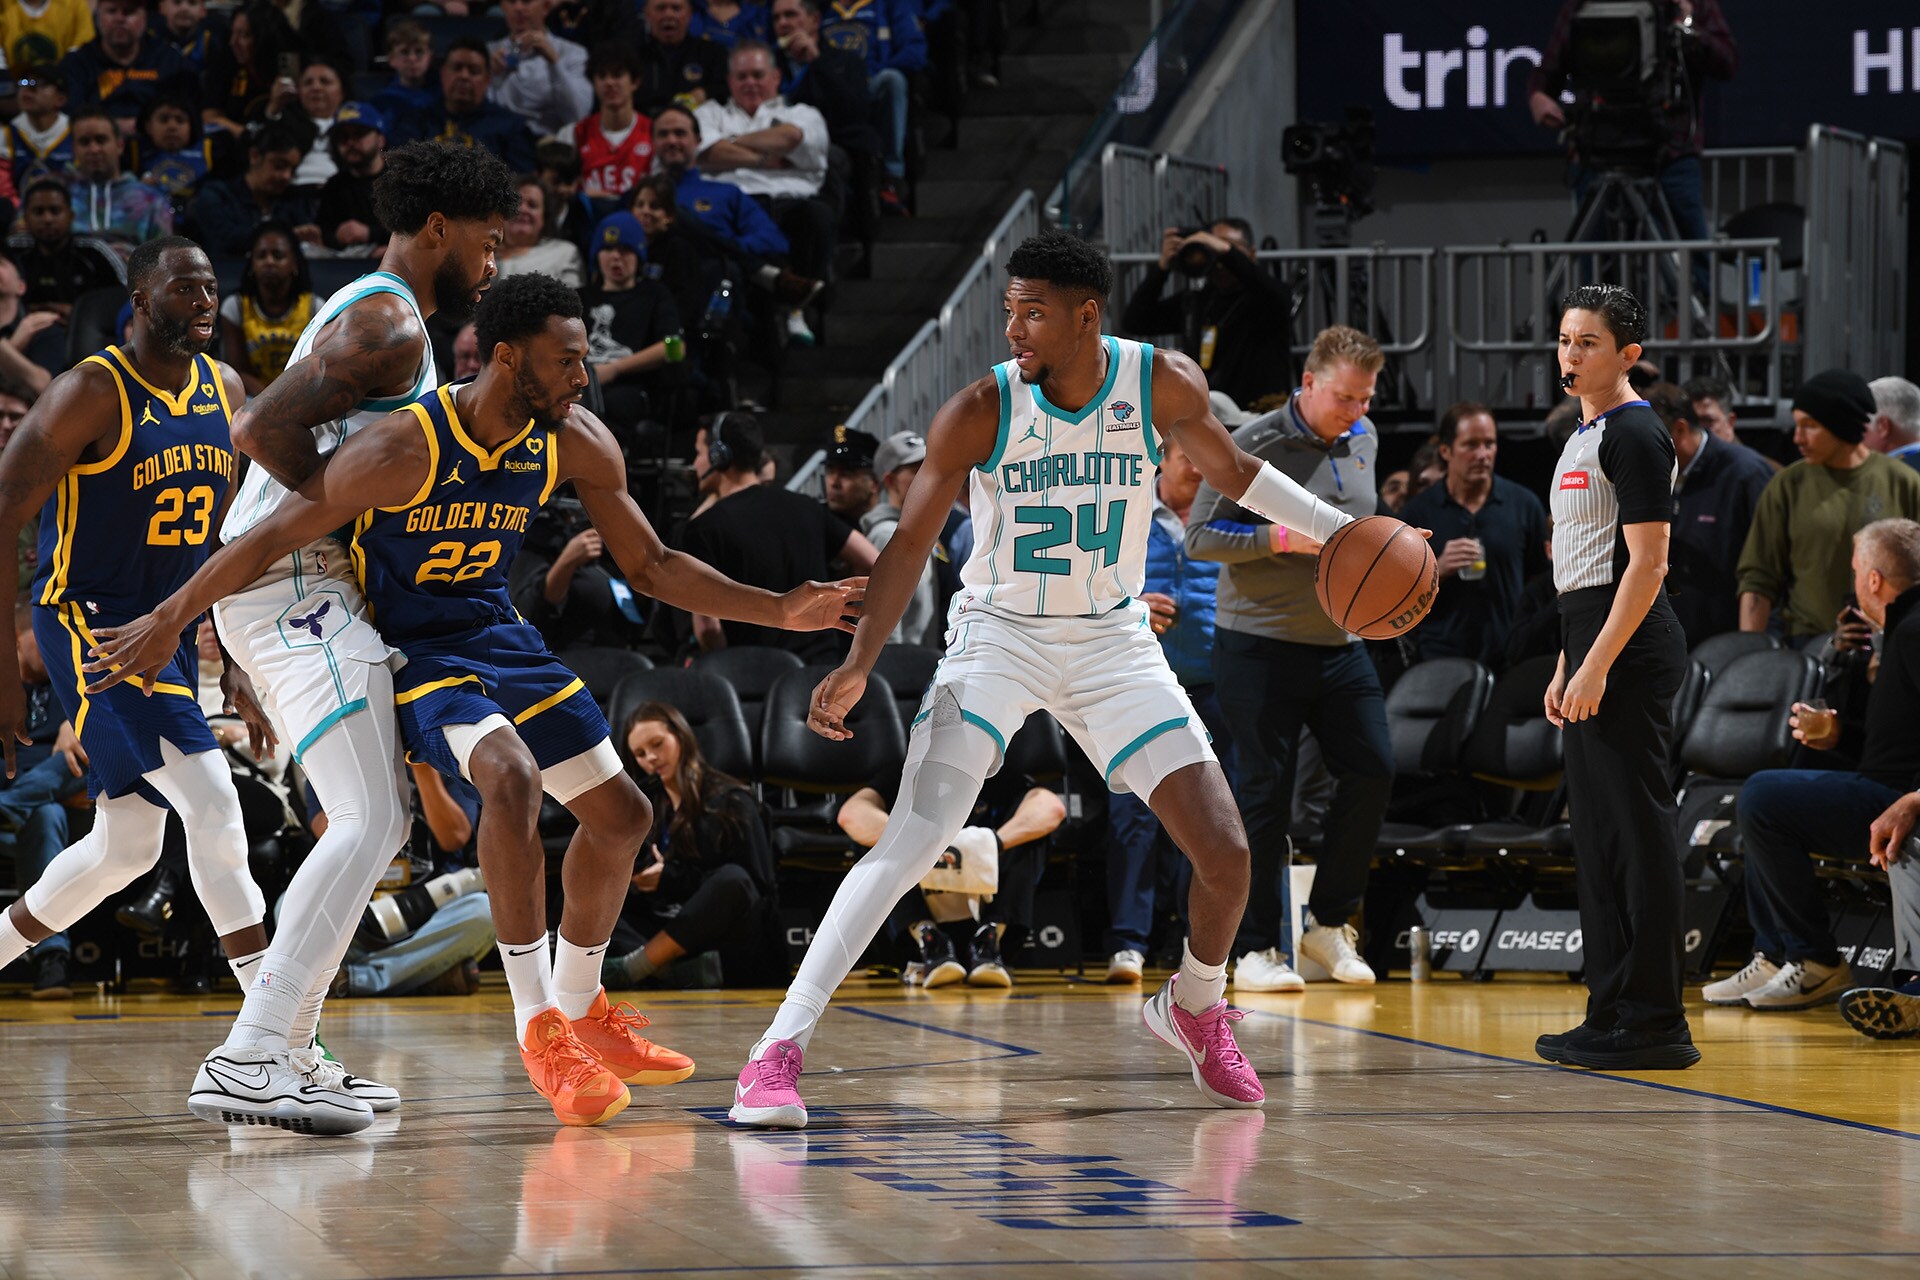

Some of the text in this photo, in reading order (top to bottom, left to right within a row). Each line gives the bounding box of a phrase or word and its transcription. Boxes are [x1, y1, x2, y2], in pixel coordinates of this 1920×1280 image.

[1106, 422, 1140, 431] FEASTABLES
[133, 443, 233, 491] GOLDEN STATE
[504, 460, 541, 471] Rakuten
[1002, 452, 1142, 493] CHARLOTTE
[1561, 476, 1585, 485] Emirates
[146, 485, 215, 545] 23
[406, 502, 530, 534] GOLDEN STATE
[1013, 499, 1127, 576] 24
[415, 539, 502, 586] 22
[1498, 930, 1567, 950] CHASE
